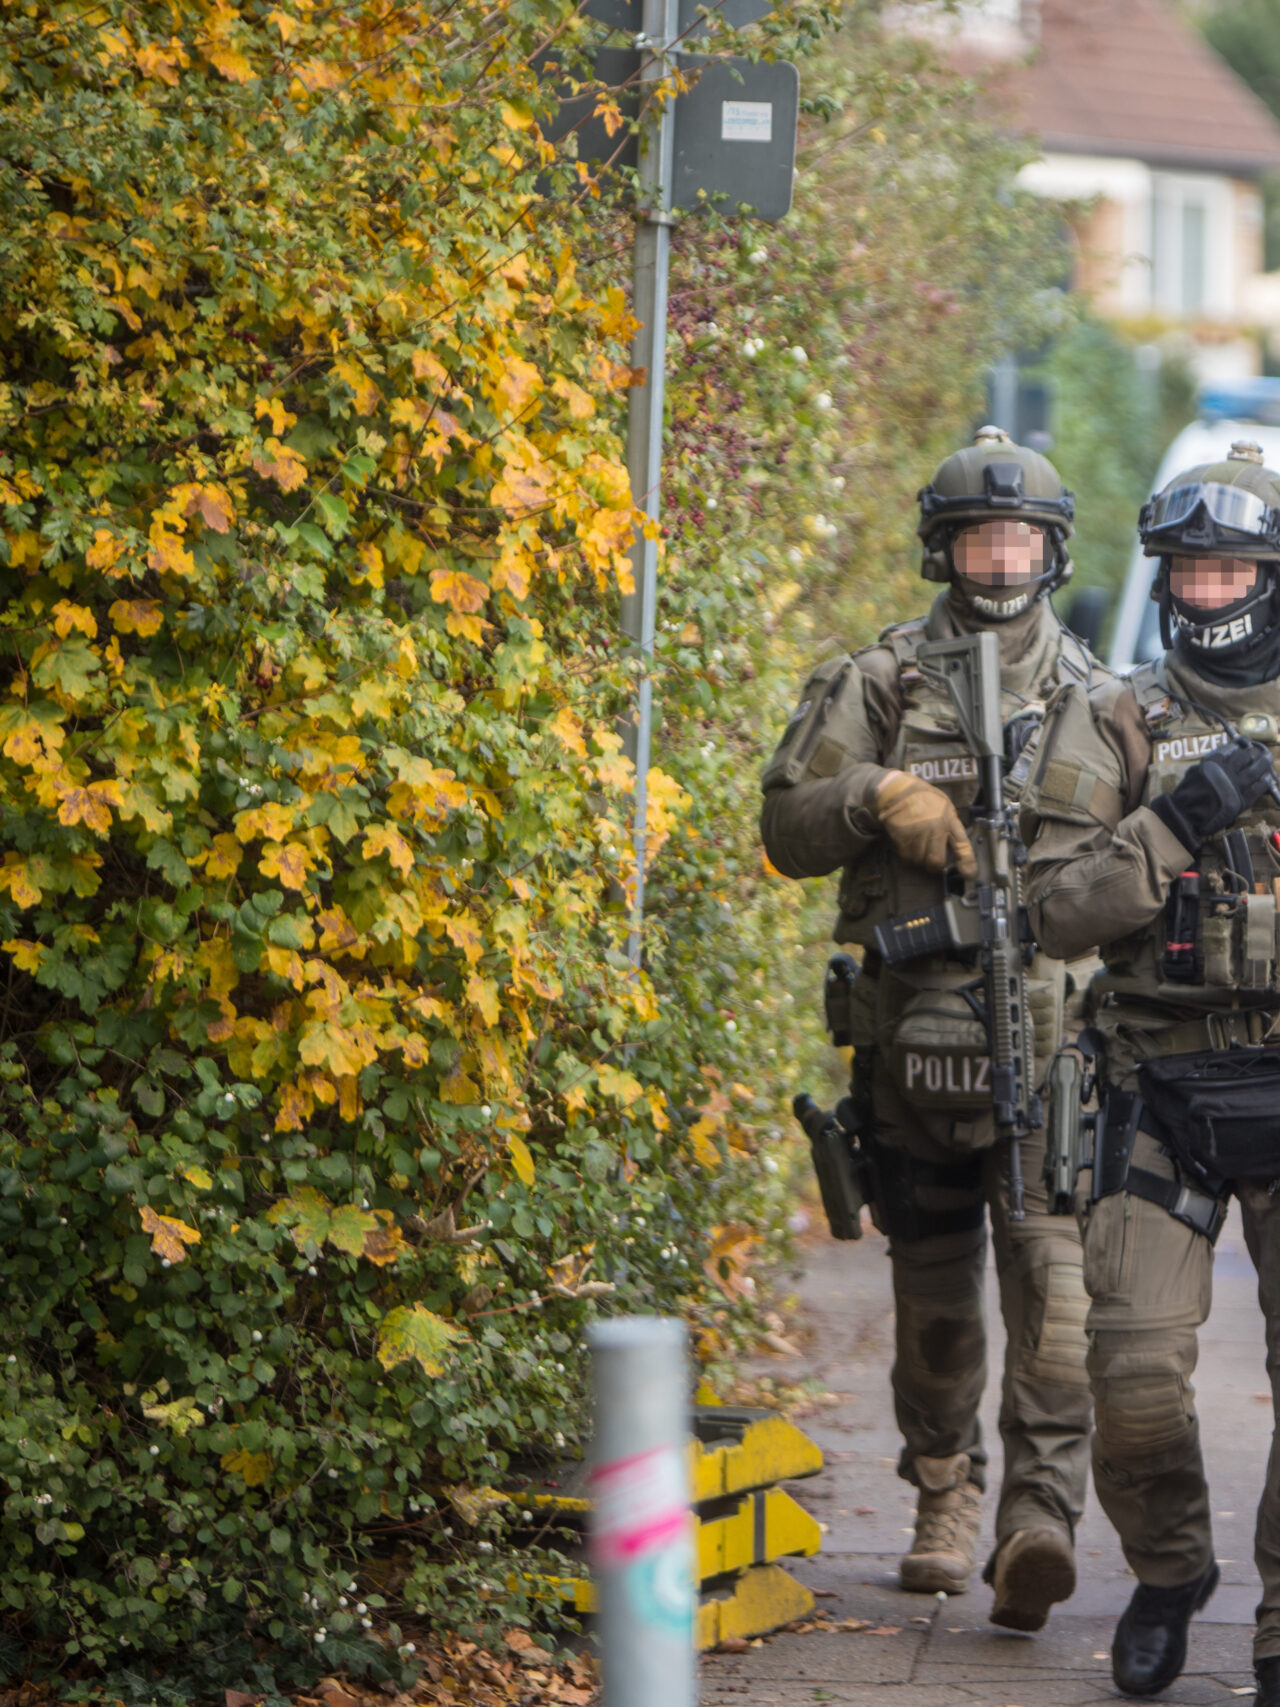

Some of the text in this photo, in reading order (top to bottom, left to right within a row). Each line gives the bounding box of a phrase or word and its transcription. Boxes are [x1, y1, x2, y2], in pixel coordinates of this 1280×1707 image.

[974, 594, 1028, 617] POLIZEI
[1158, 732, 1228, 762] POLIZEI
[910, 757, 978, 780] POLIZEI
[905, 1052, 992, 1092] POLIZ
